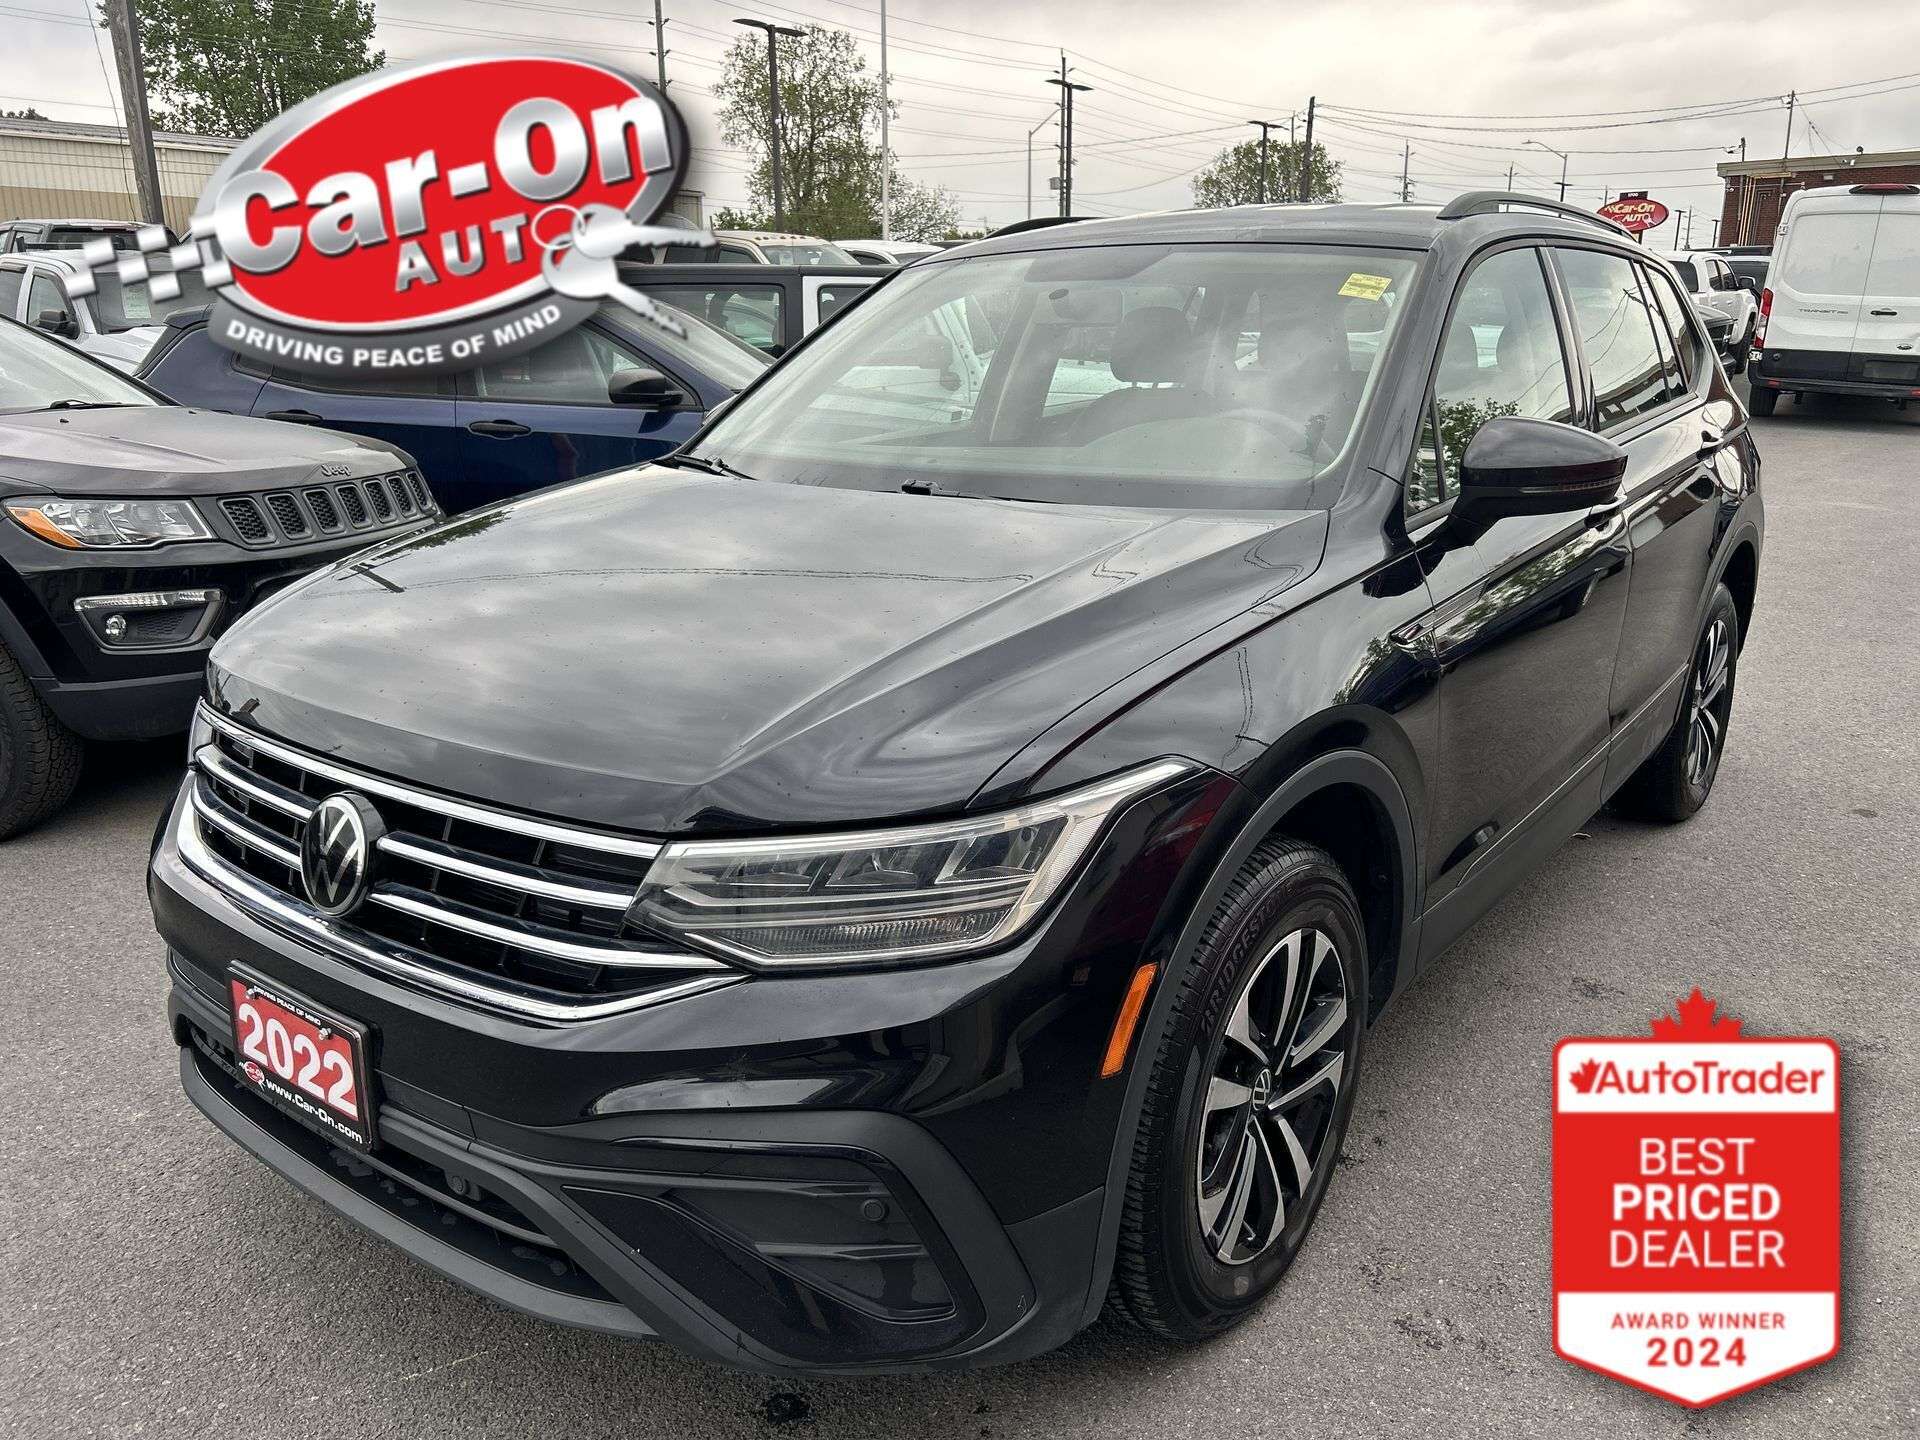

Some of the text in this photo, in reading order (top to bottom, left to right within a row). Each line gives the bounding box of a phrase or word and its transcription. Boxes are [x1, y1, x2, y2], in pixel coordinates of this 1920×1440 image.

[321, 463, 351, 477] Jeep
[238, 1003, 358, 1118] 2022
[266, 1079, 363, 1144] www.Car-On.com
